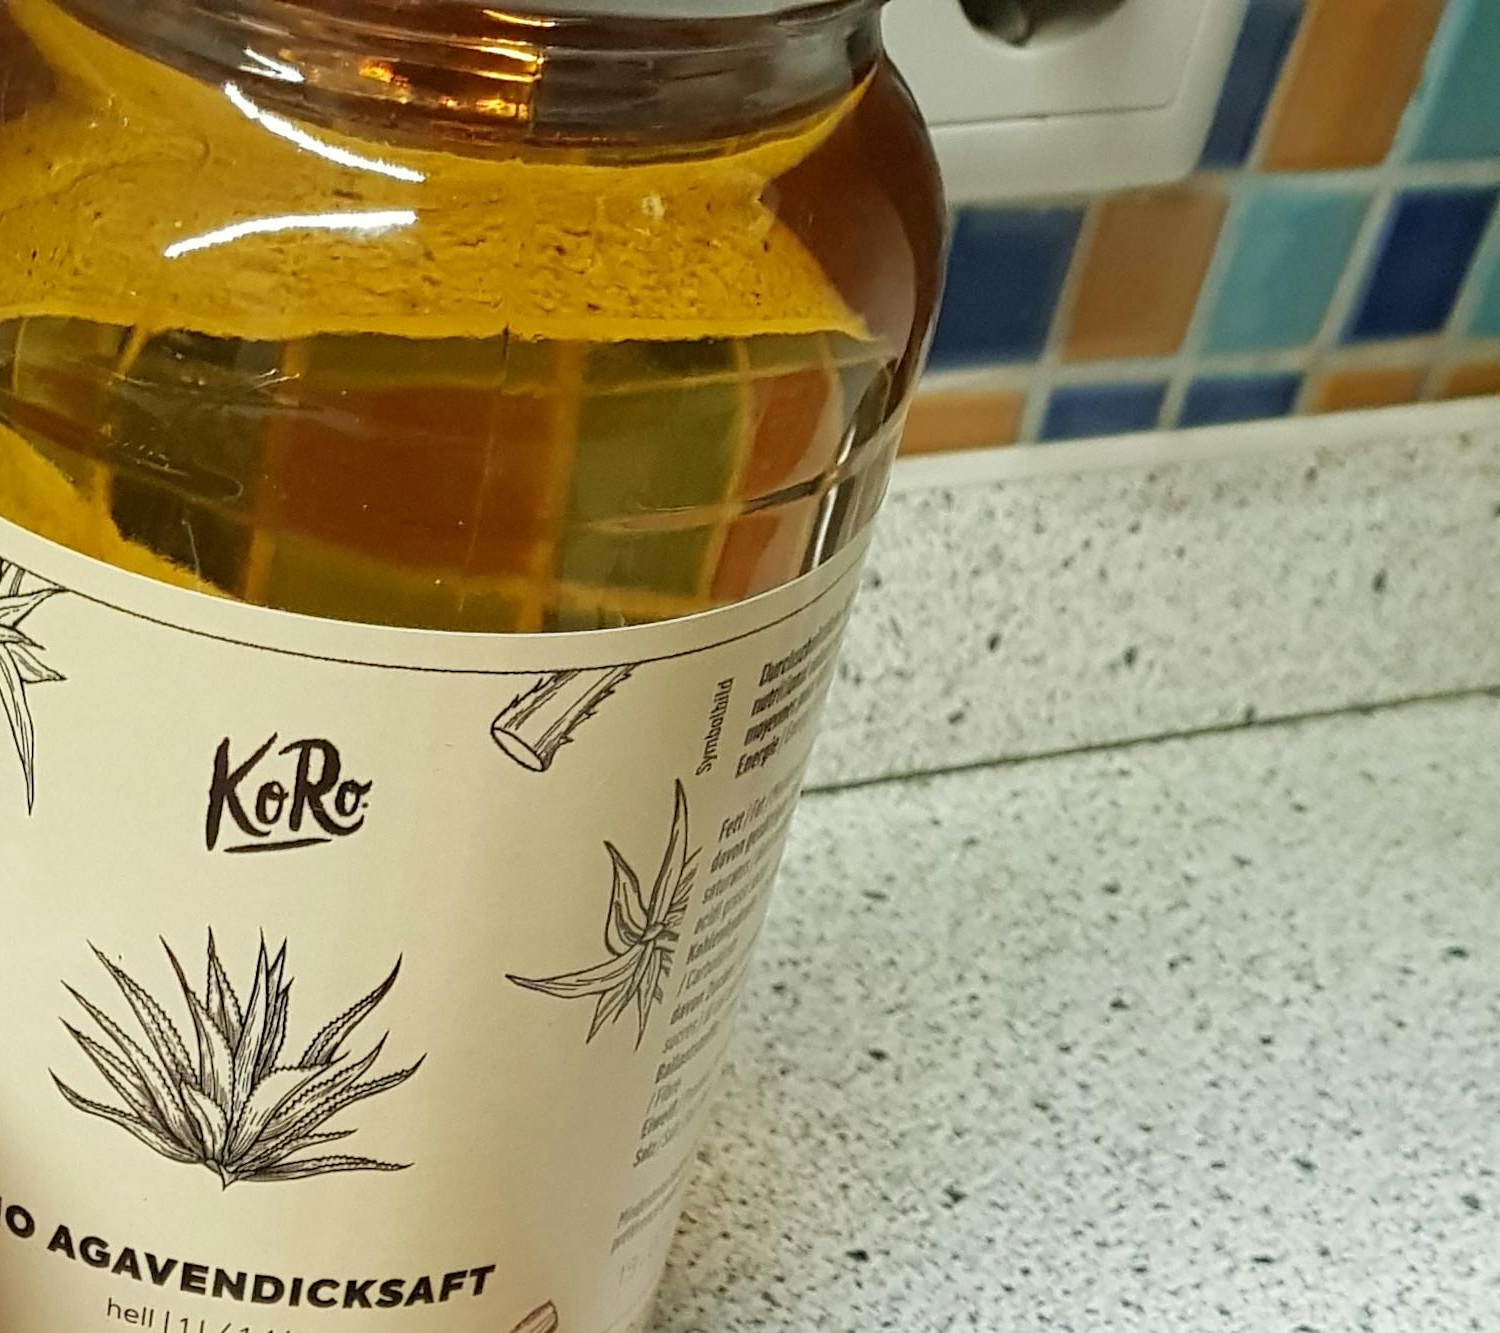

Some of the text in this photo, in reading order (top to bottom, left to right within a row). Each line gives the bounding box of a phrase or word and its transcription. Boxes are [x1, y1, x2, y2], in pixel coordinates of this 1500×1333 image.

[695, 677, 736, 777] Symbolbild
[206, 732, 372, 853] KoRo
[47, 1224, 496, 1310] AGAVENDICKSAFT
[107, 1297, 154, 1328] hell
